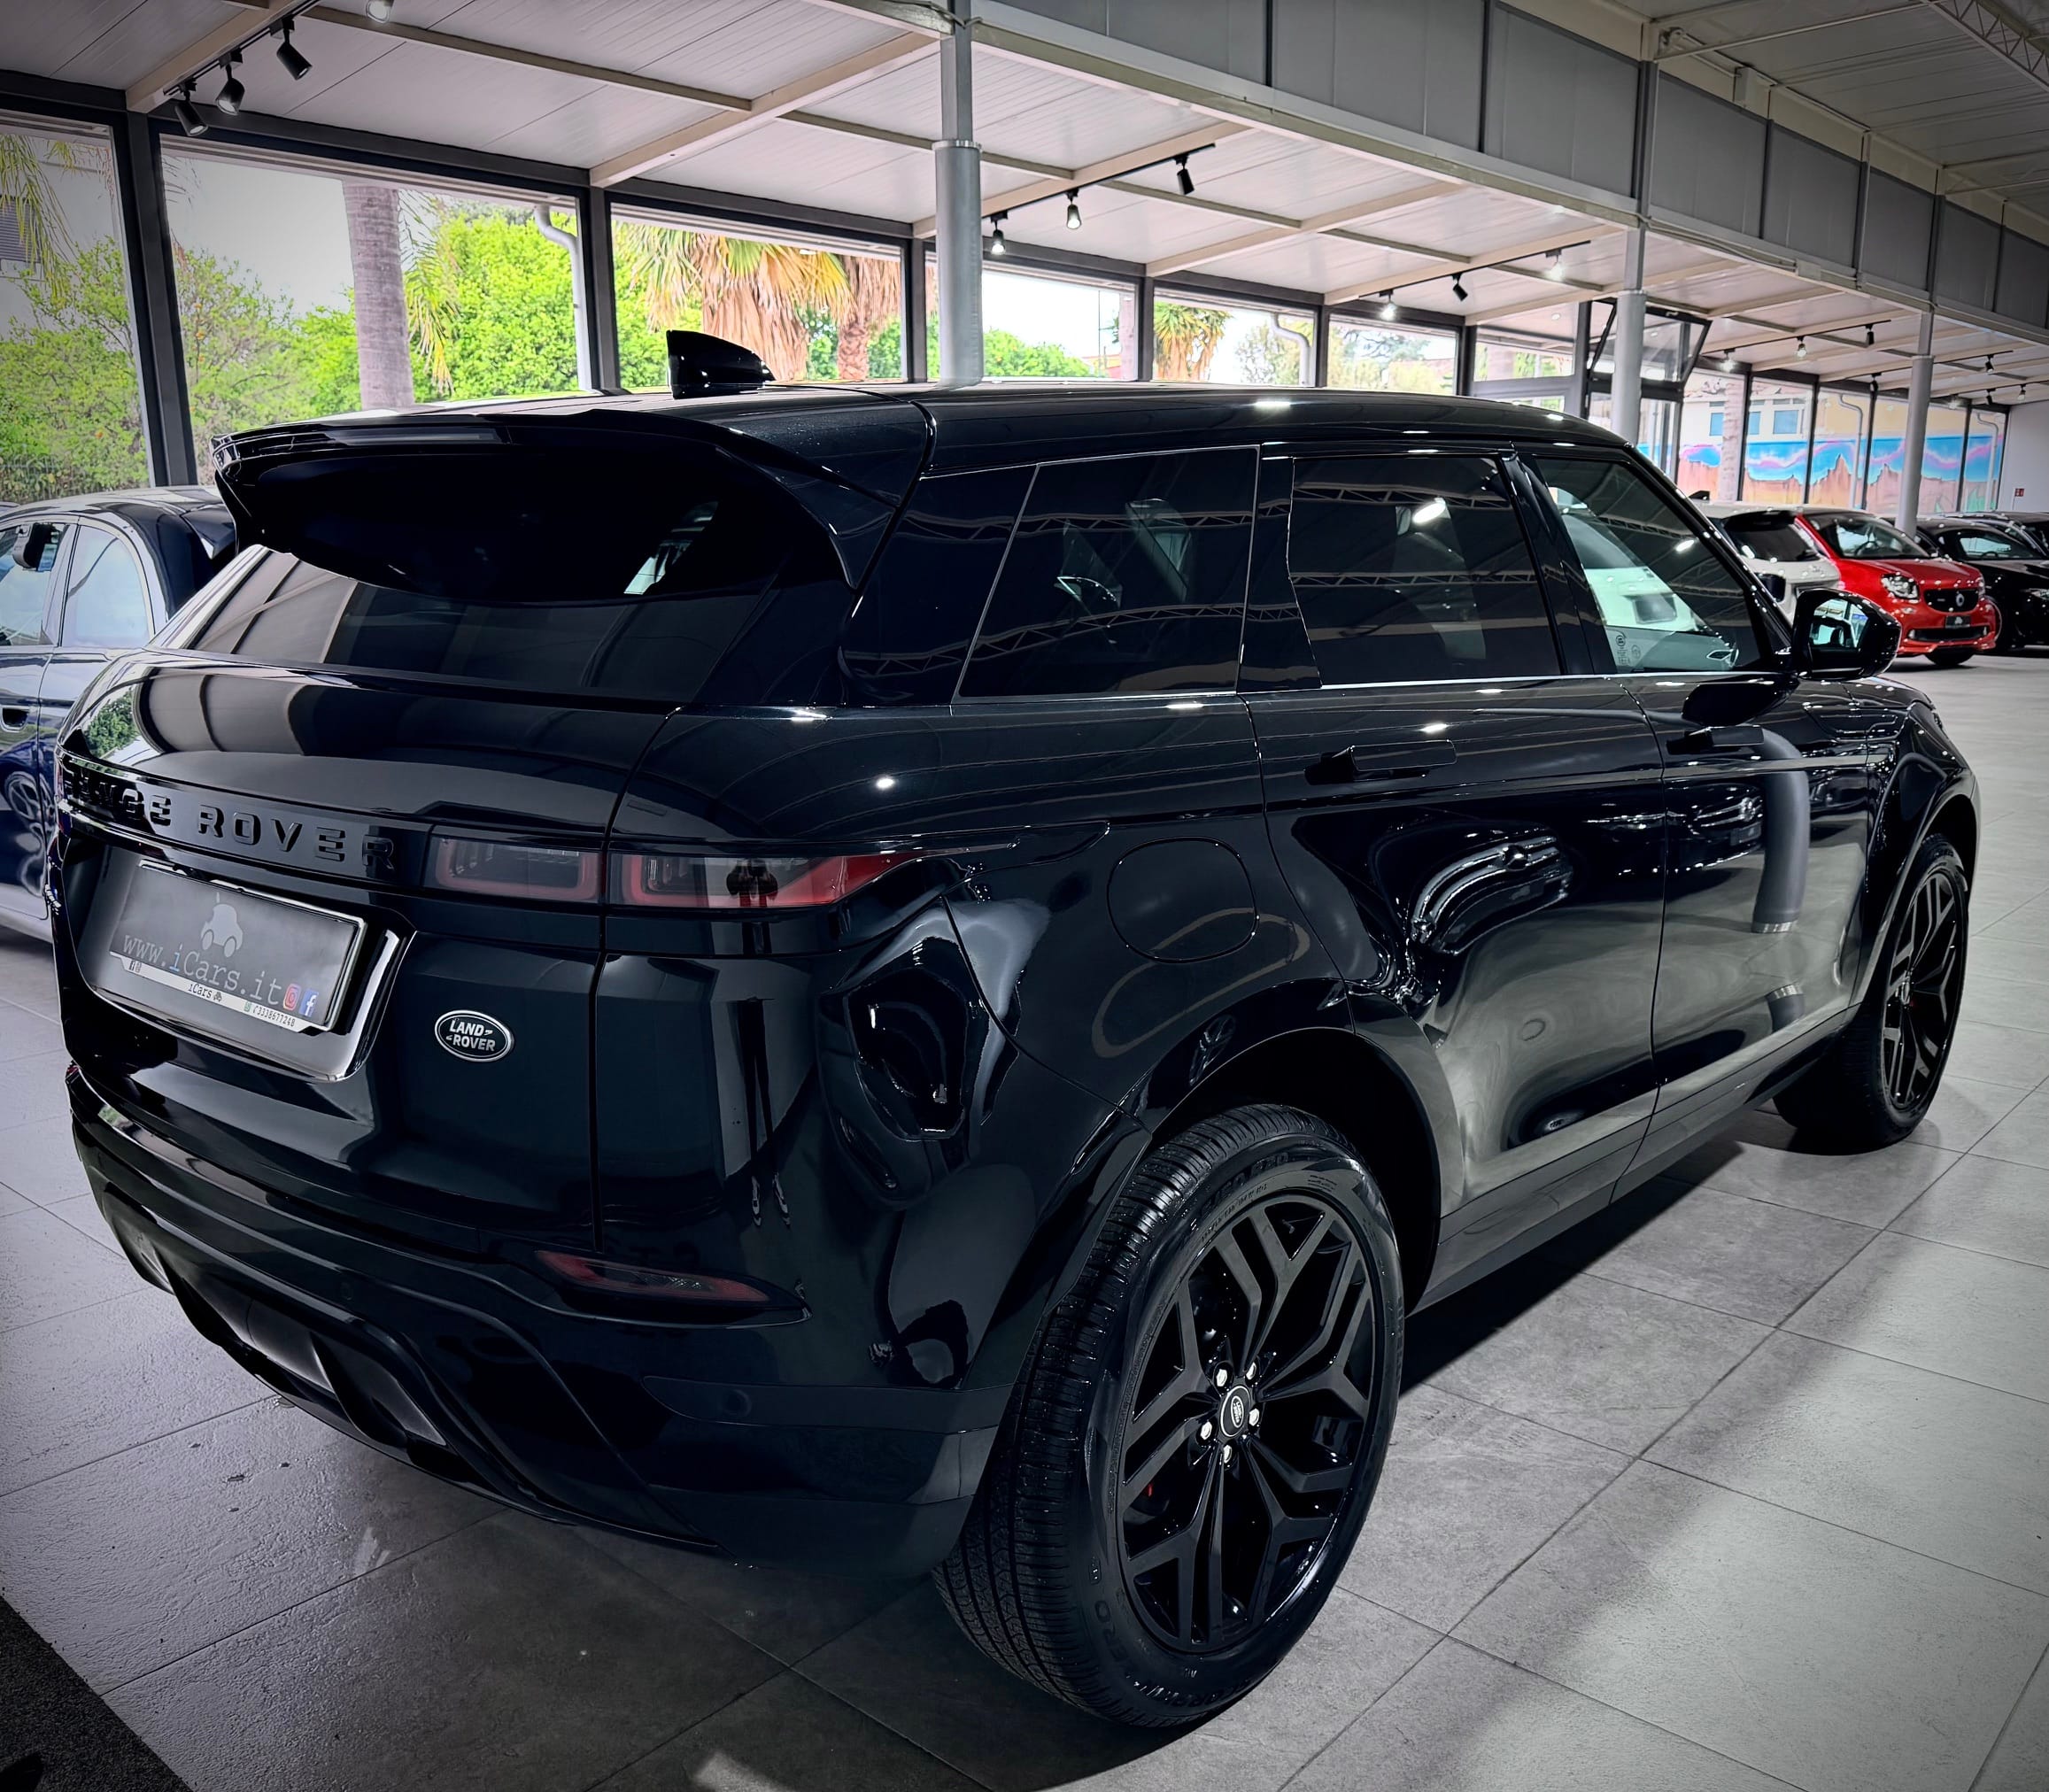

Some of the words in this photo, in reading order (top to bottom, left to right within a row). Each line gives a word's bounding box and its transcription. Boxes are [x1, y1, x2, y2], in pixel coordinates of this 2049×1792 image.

[198, 804, 396, 871] ROVER
[122, 935, 282, 1005] www.iCars.it
[189, 983, 212, 1000] iCars
[449, 1020, 484, 1037] LAND
[452, 1034, 496, 1052] ROVER
